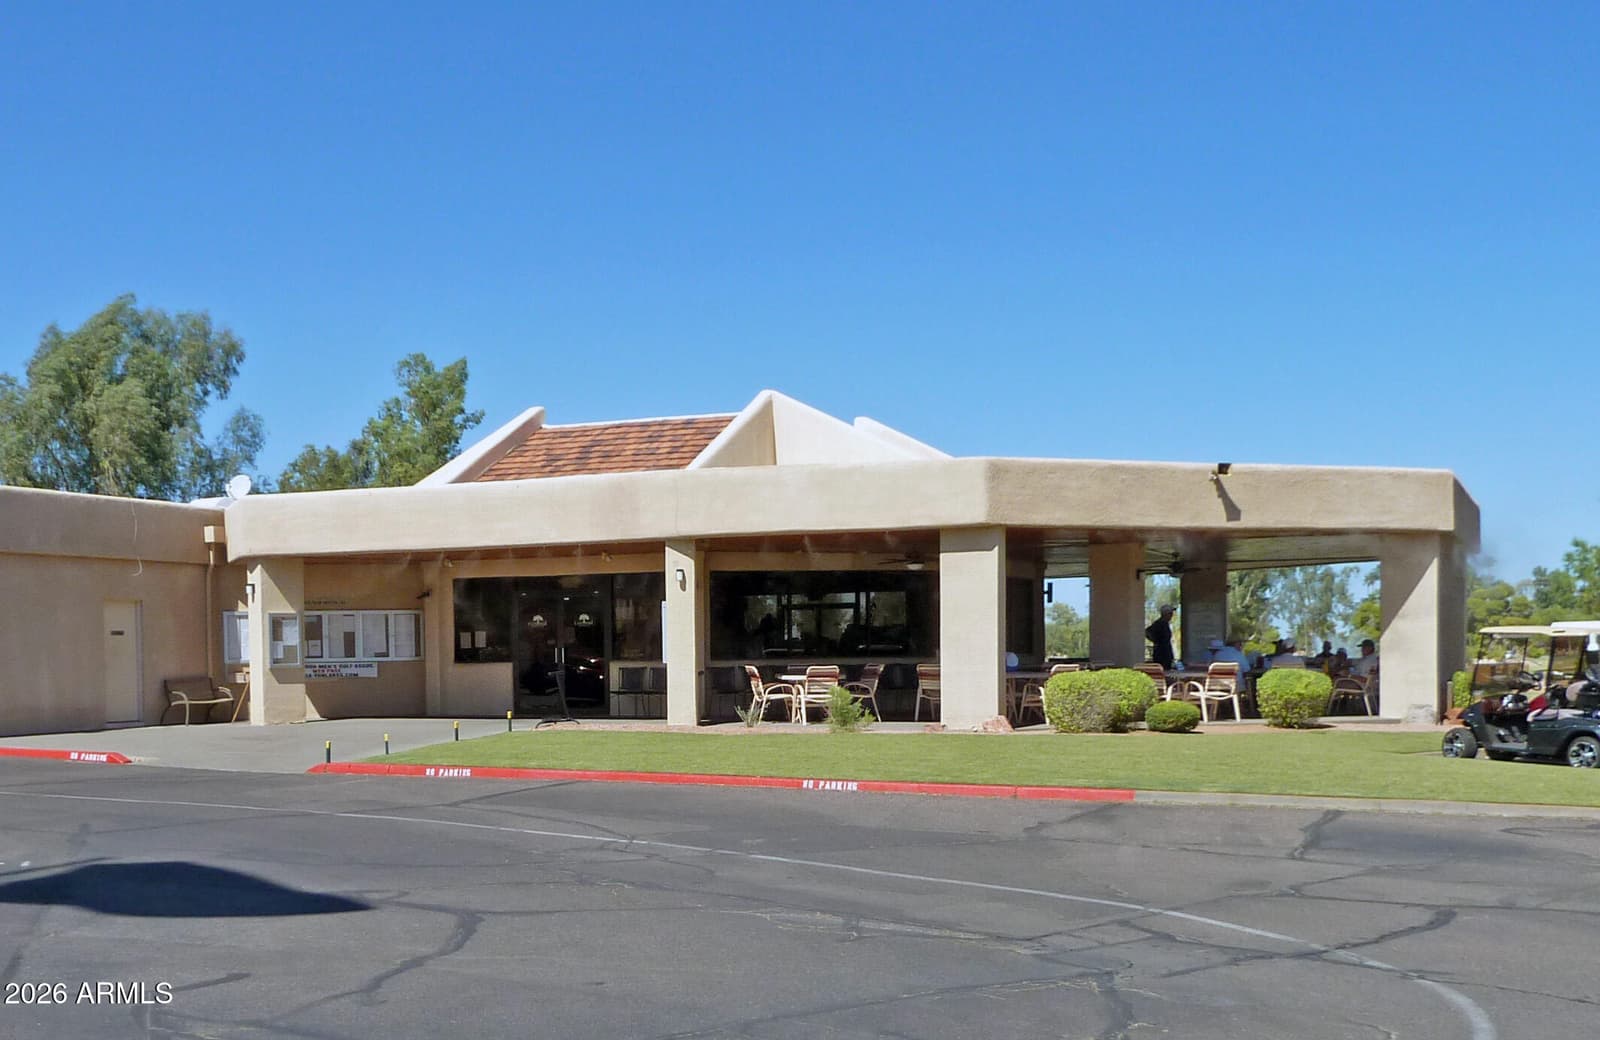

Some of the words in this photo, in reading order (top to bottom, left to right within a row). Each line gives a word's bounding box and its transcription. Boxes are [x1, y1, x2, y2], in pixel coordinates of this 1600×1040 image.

[425, 767, 435, 776] NO
[438, 767, 471, 777] PARKING
[802, 779, 814, 789] NO
[818, 780, 857, 790] PARKING
